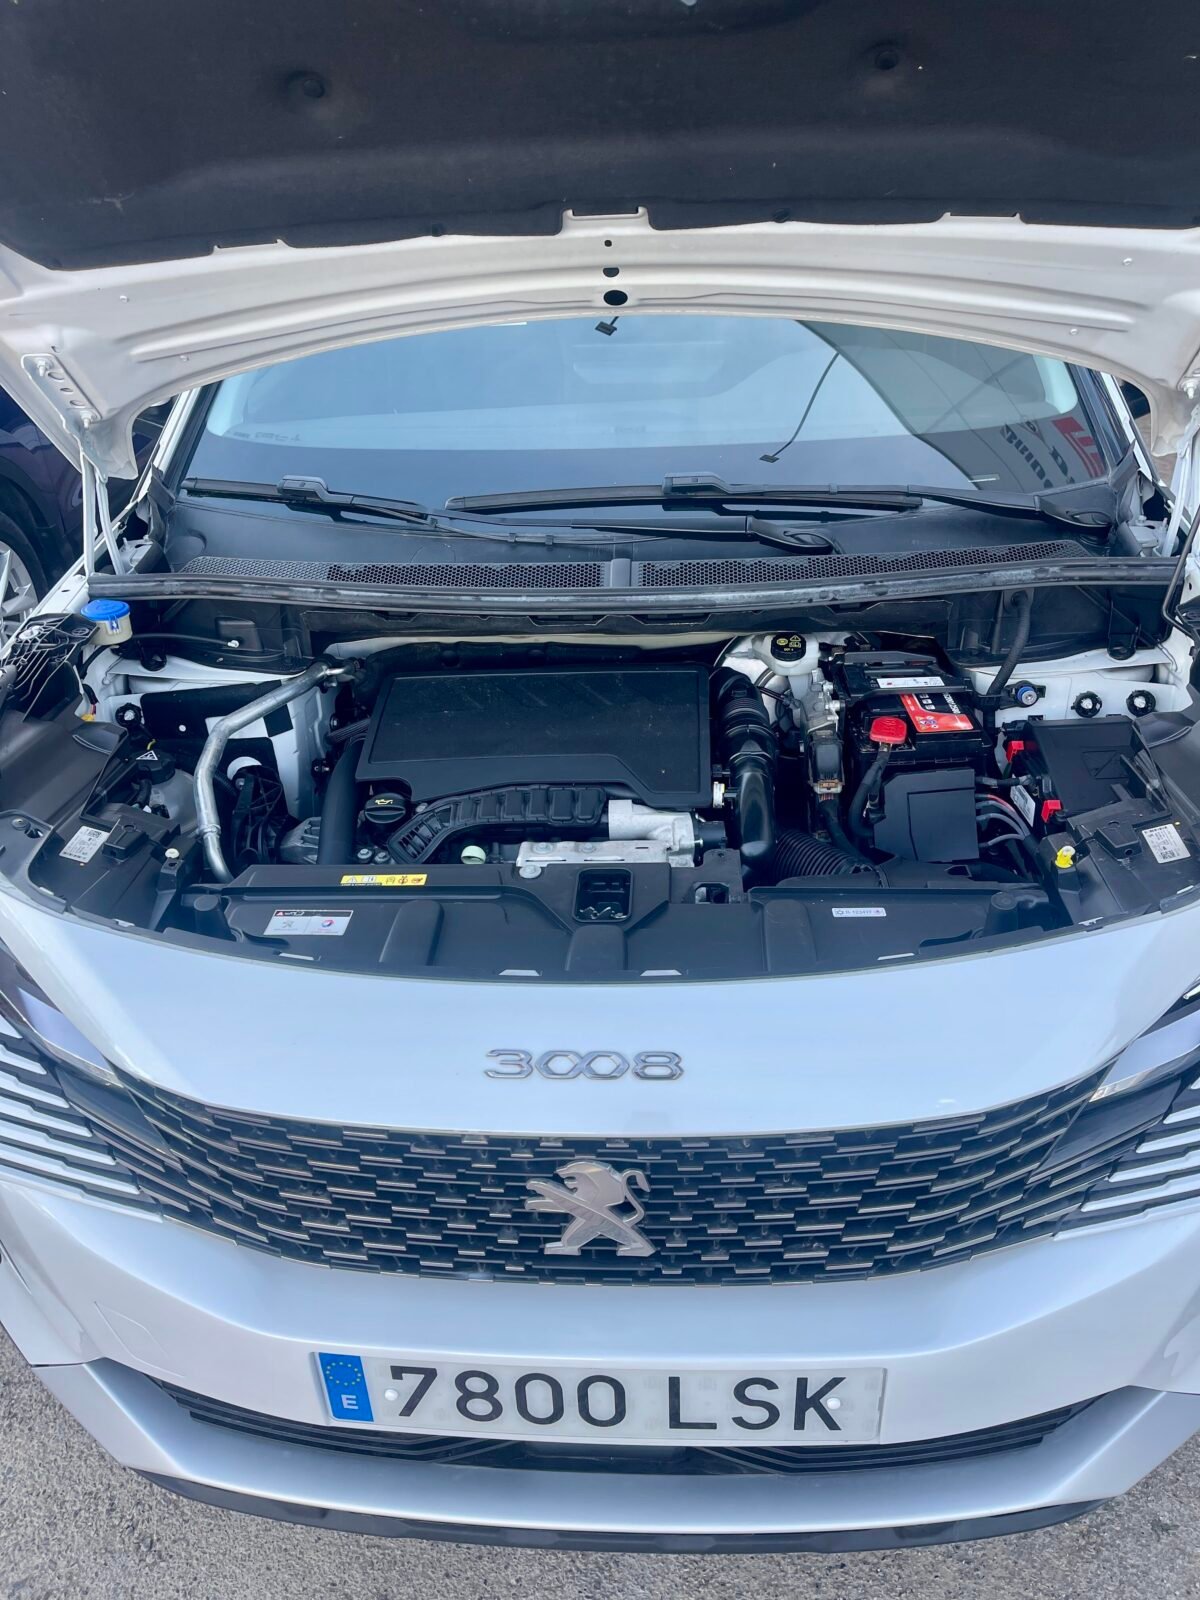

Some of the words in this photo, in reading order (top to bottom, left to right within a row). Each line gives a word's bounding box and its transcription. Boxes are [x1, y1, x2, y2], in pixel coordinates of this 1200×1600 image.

[484, 1049, 684, 1080] 3008
[341, 1394, 358, 1410] E
[390, 1365, 626, 1427] 7800
[668, 1376, 846, 1431] LSK
